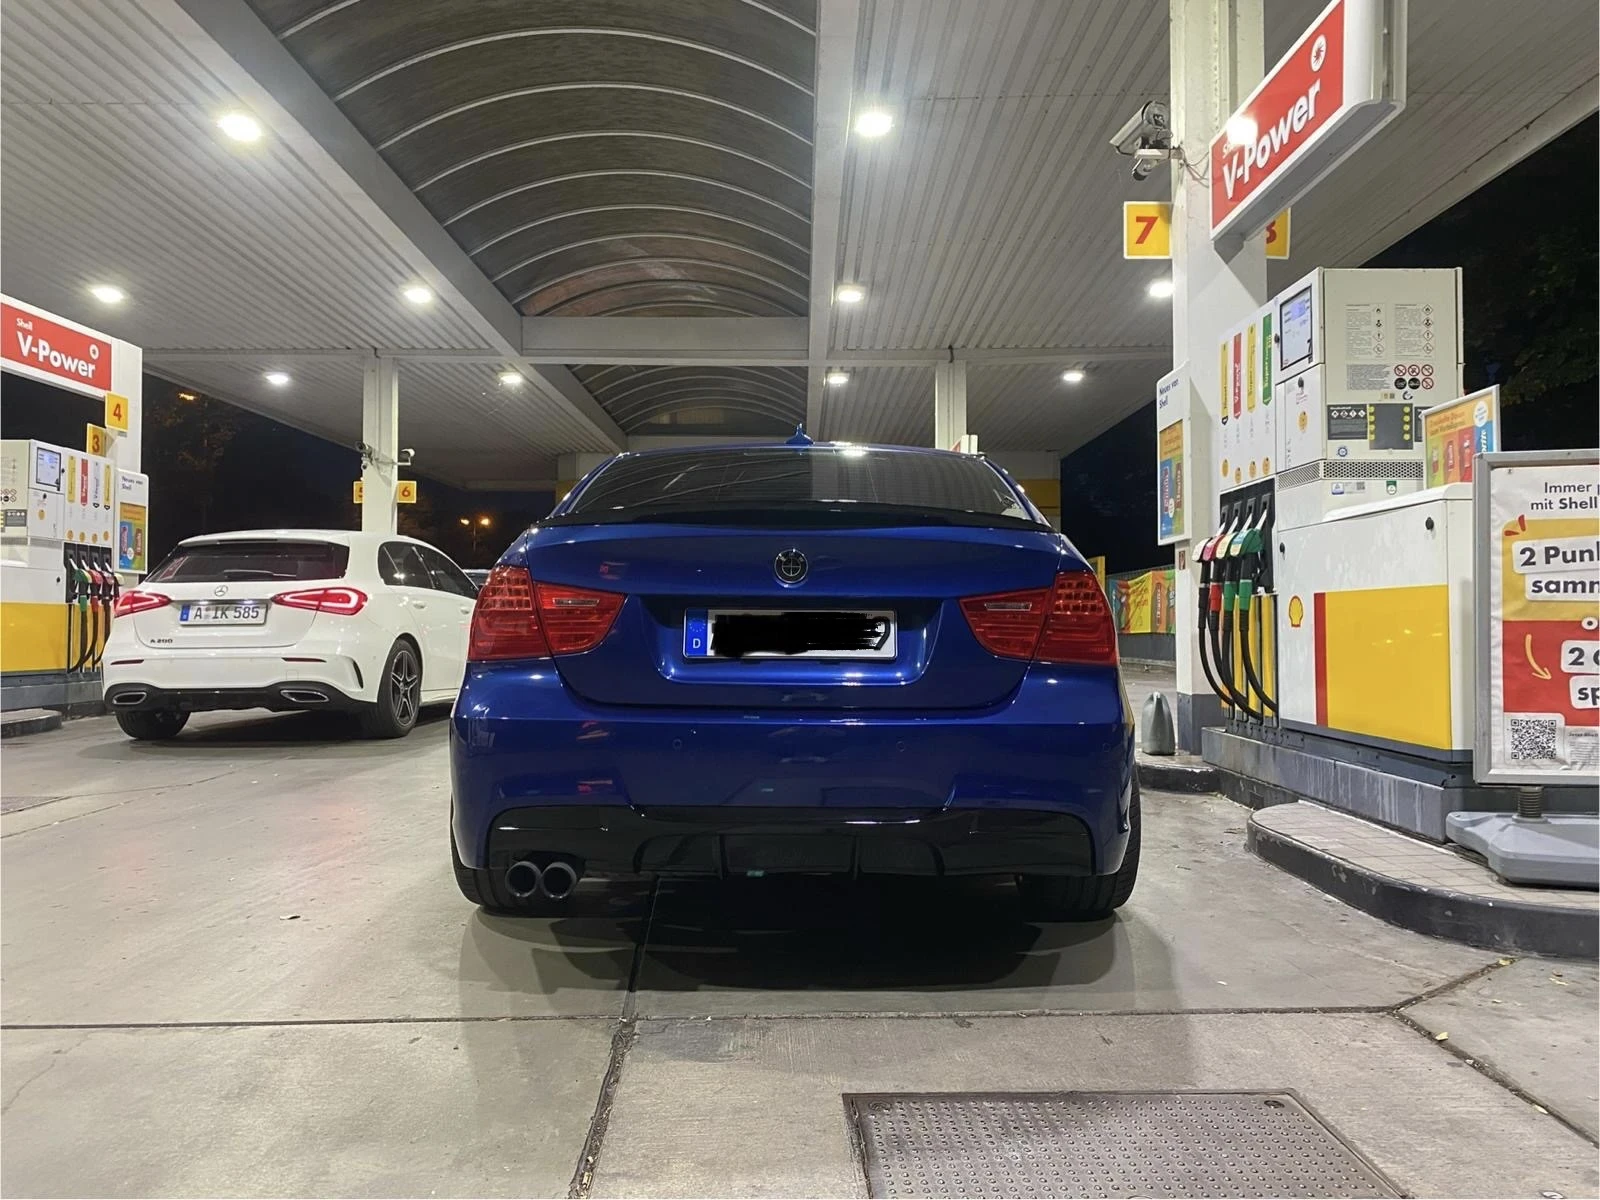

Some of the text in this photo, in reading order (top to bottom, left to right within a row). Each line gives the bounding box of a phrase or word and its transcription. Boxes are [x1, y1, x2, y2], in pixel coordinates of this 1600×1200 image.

[1222, 79, 1321, 200] V-Power
[1135, 216, 1159, 245] 7
[16, 317, 33, 332] Shell
[16, 331, 96, 379] V-Power
[113, 403, 122, 421] 4
[92, 434, 100, 454] 3
[402, 486, 411, 498] 6
[1544, 481, 1592, 494] Immer
[1530, 496, 1598, 511] mit Shell
[1519, 546, 1537, 567] 2
[193, 605, 260, 620] A IK 585
[692, 638, 701, 649] D
[1568, 646, 1585, 666] 2
